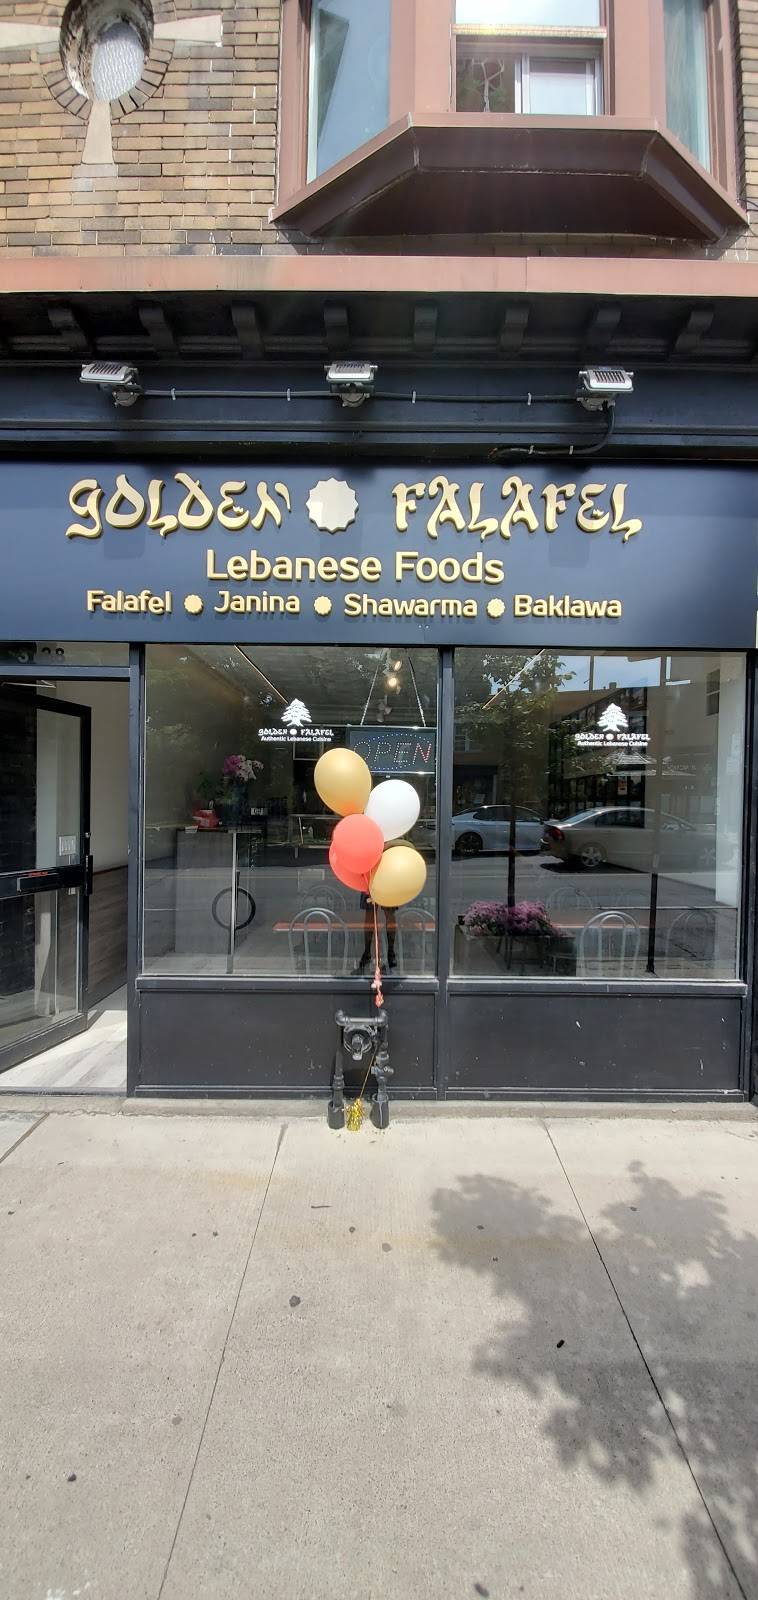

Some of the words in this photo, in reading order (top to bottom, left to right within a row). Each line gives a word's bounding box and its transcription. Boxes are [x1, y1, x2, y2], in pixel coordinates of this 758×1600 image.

[65, 472, 292, 539] GOLDEN
[391, 475, 643, 542] FALAFEL
[206, 549, 383, 582] Lebanese
[395, 551, 505, 584] Foods
[86, 589, 172, 615] Falafel
[214, 590, 300, 615] Janina
[344, 593, 478, 617] Shawarma
[514, 594, 622, 618] Baklawa
[354, 741, 433, 766] OPEN
